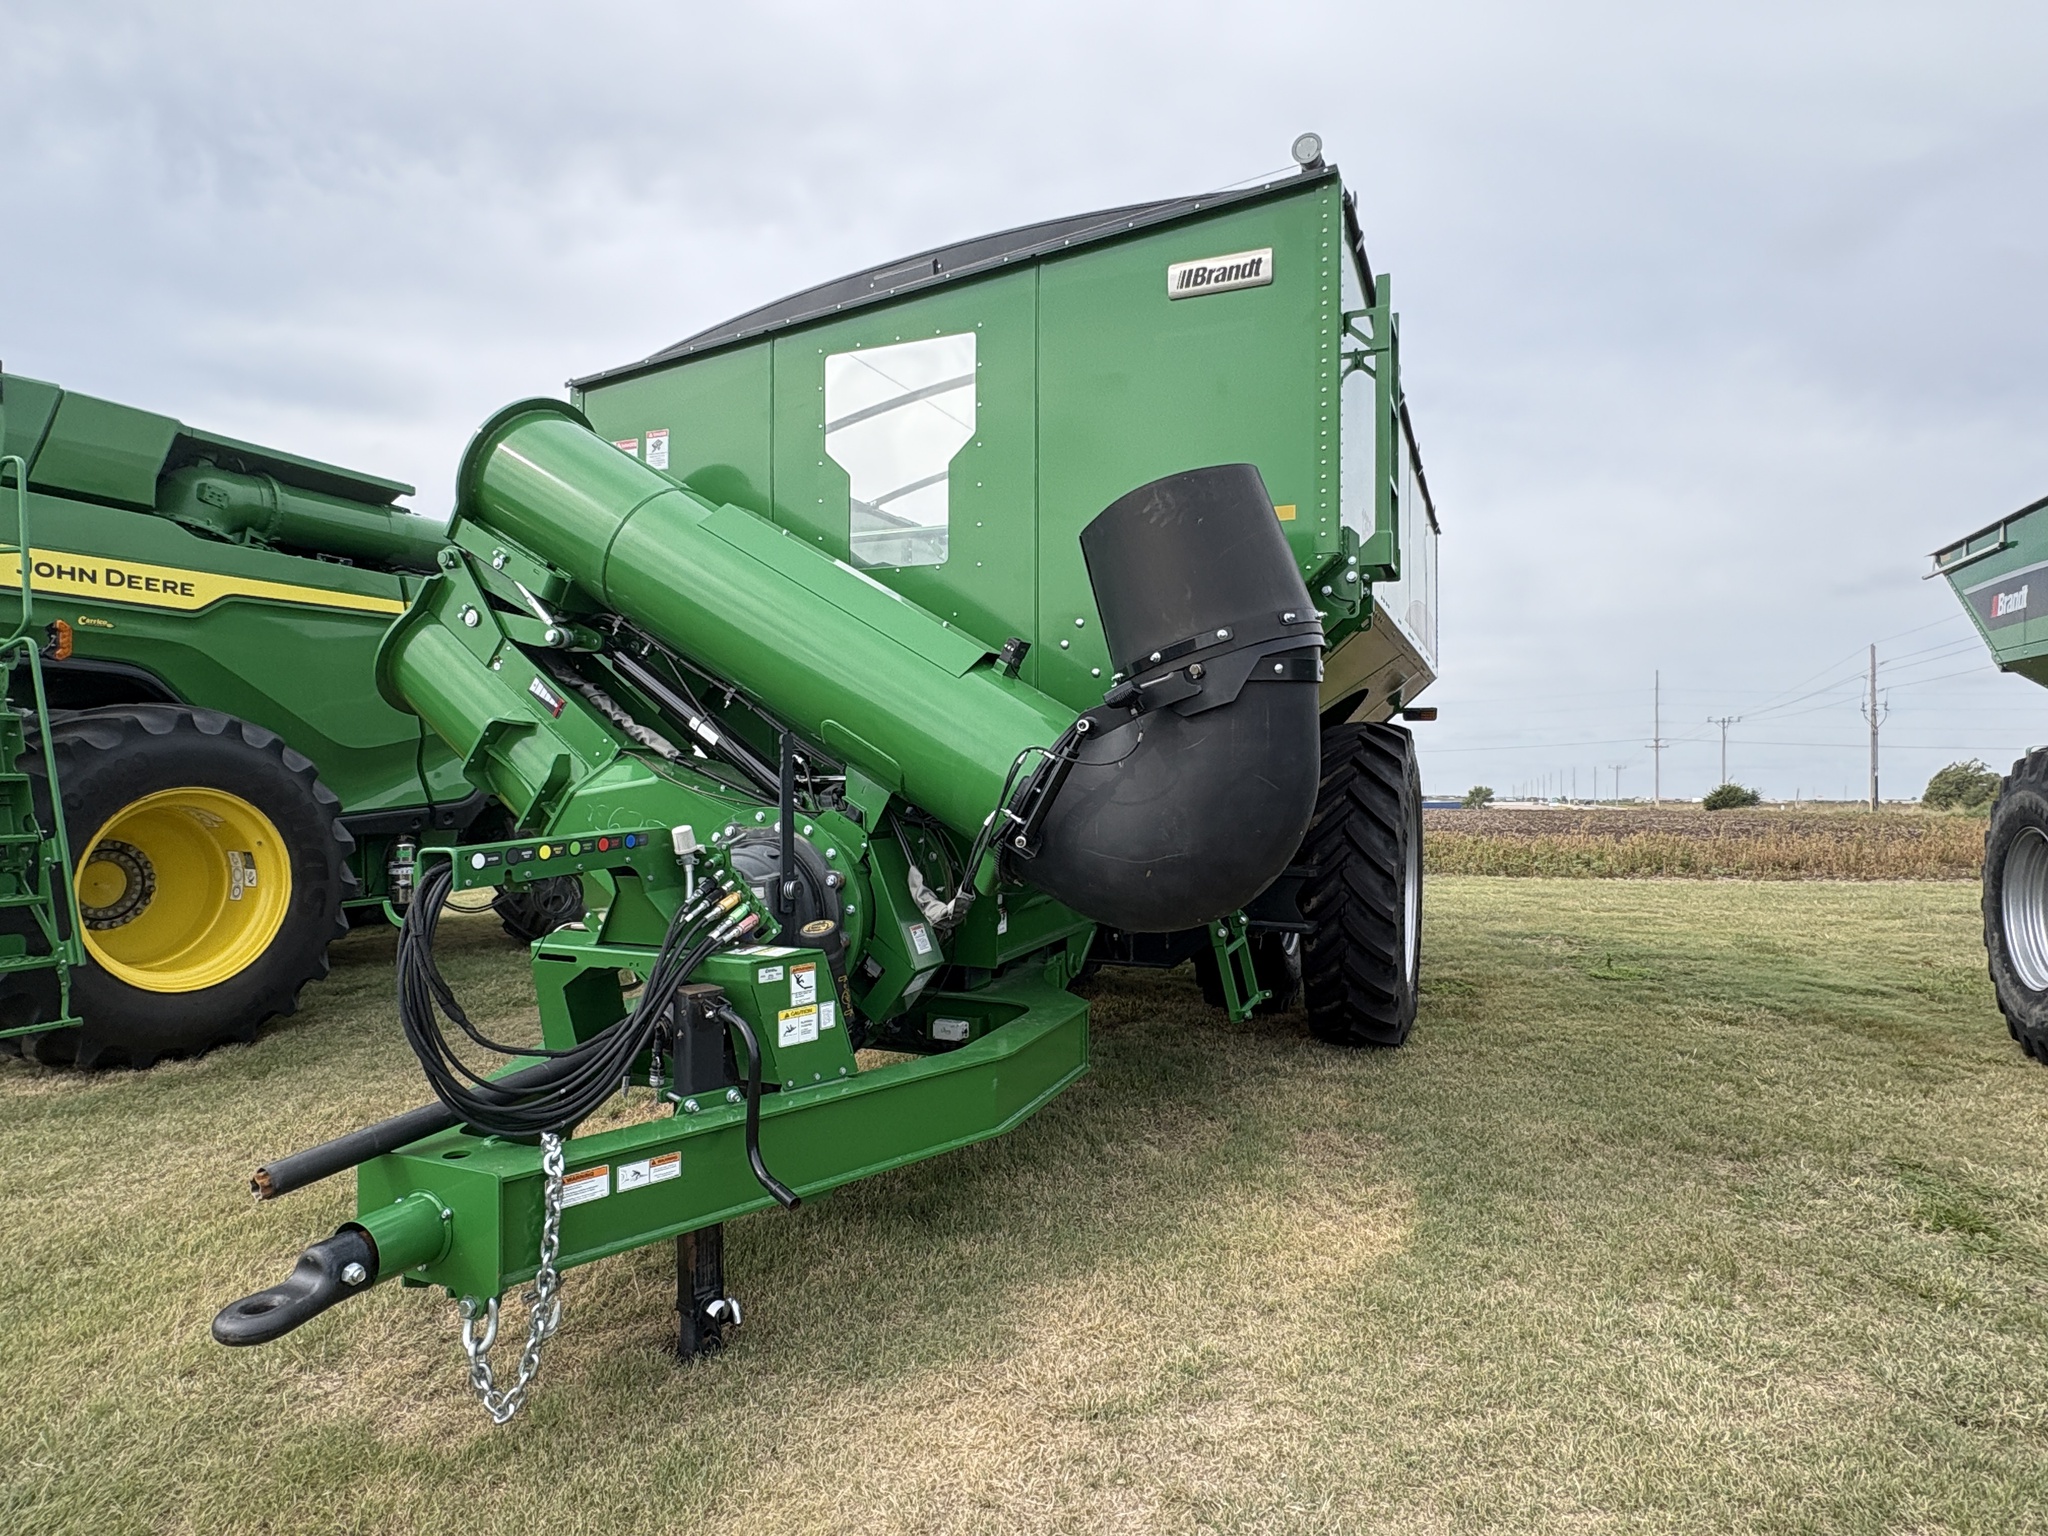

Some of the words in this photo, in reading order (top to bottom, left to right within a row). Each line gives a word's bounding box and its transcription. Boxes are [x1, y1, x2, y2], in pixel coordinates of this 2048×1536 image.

[1191, 257, 1263, 288] Brandt
[105, 568, 196, 598] DEERE
[1996, 584, 2029, 617] Brandt
